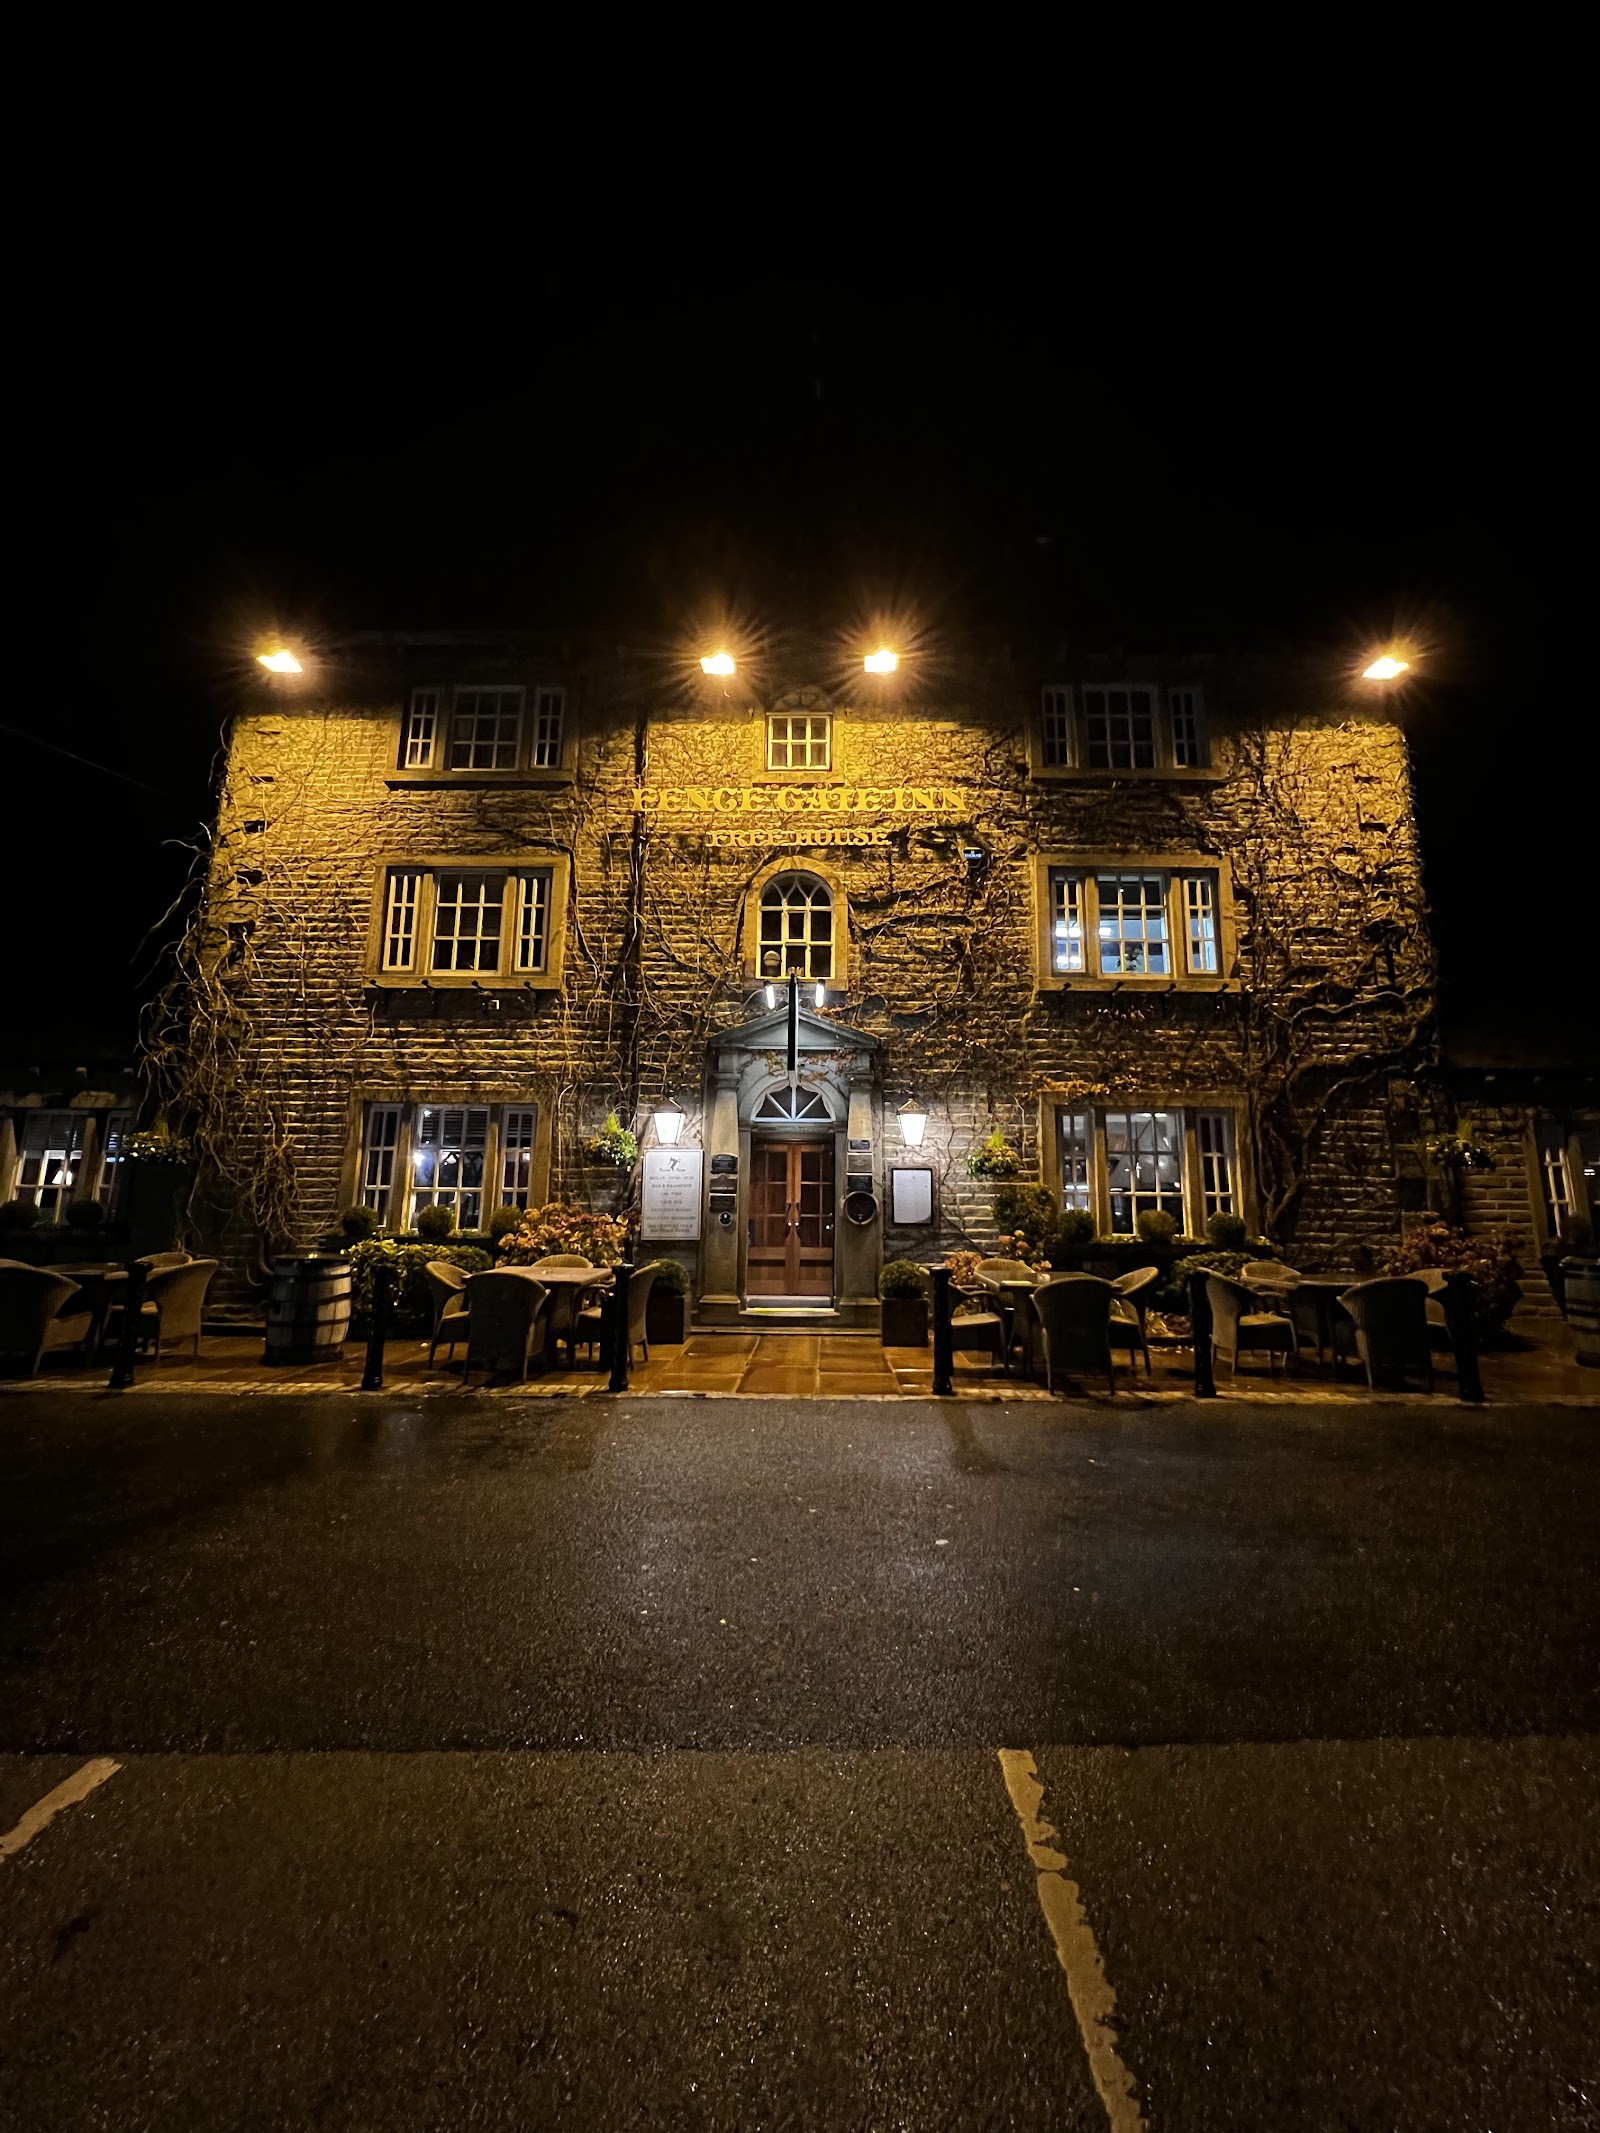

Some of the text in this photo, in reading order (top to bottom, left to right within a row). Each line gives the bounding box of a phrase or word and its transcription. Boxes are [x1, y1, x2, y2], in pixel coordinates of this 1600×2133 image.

[632, 787, 967, 812] FENCE GATE INN
[709, 828, 892, 847] FREE HOUSE
